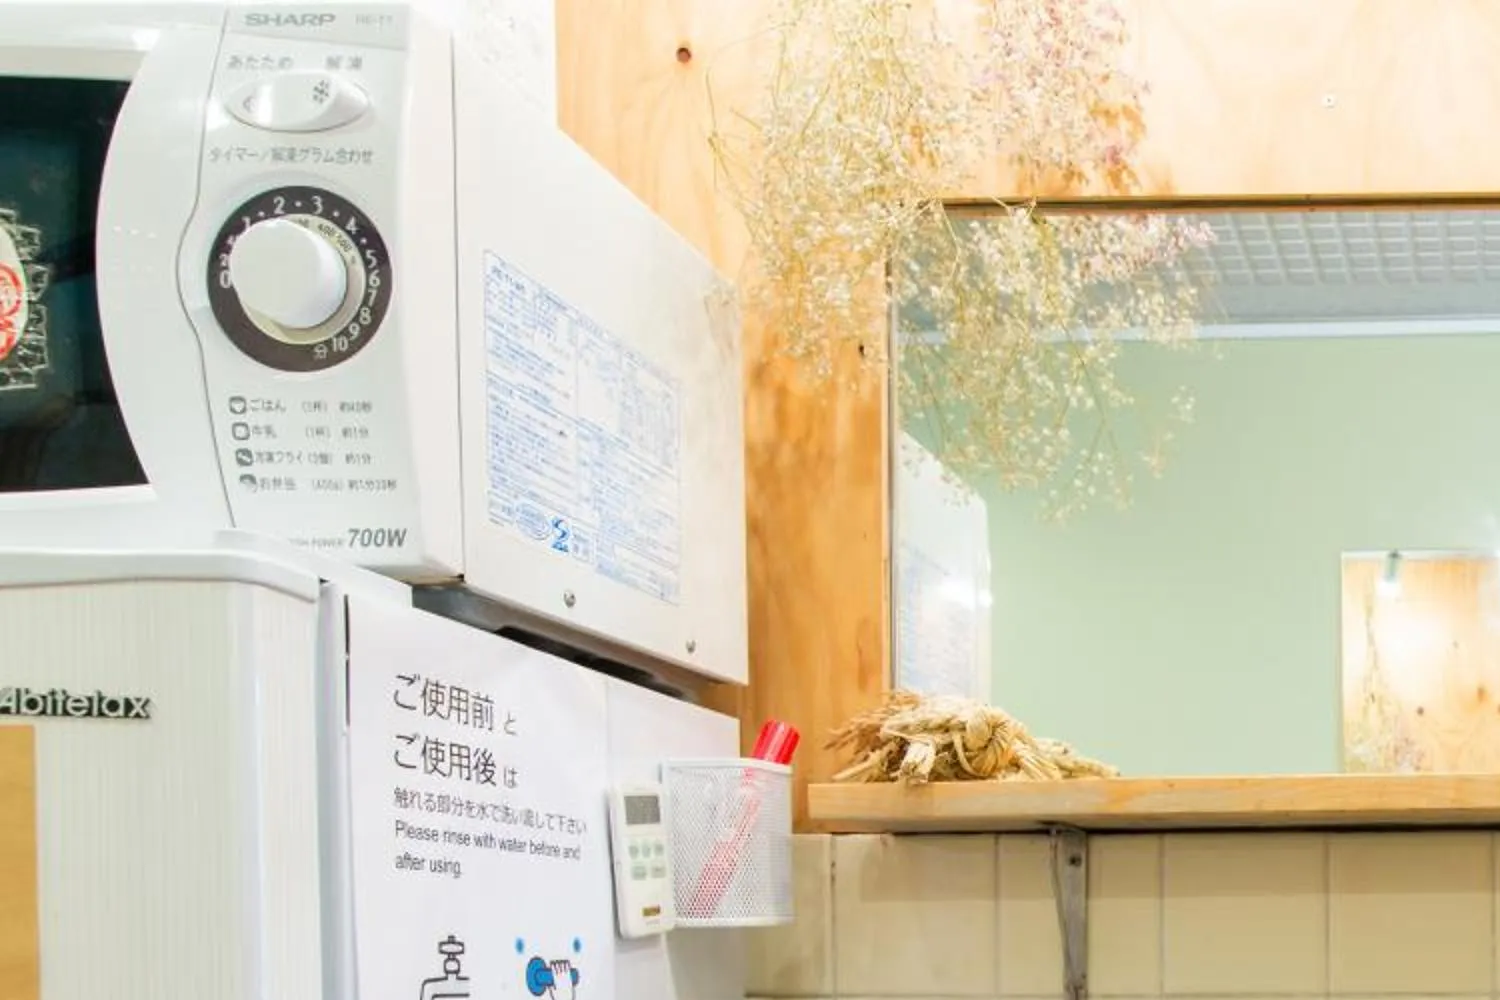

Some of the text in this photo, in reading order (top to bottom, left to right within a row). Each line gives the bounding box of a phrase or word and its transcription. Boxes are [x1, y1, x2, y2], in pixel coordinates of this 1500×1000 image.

[244, 12, 336, 26] SHARP
[227, 55, 294, 70] あたため
[273, 197, 285, 214] 2
[312, 196, 324, 214] 3
[345, 216, 360, 235] 4
[366, 250, 378, 269] 5
[368, 270, 380, 288] 6
[367, 289, 377, 306] 7
[359, 307, 372, 325] 8
[349, 323, 361, 340] 9
[331, 335, 349, 353] 10
[249, 399, 287, 414] ごはん
[348, 527, 407, 548] 700W
[0, 688, 150, 718] Abitelax
[394, 786, 586, 834] 触れる部分を水で洗い流して下さい
[395, 820, 581, 861] Please rinse with water before and
[395, 851, 424, 872] after
